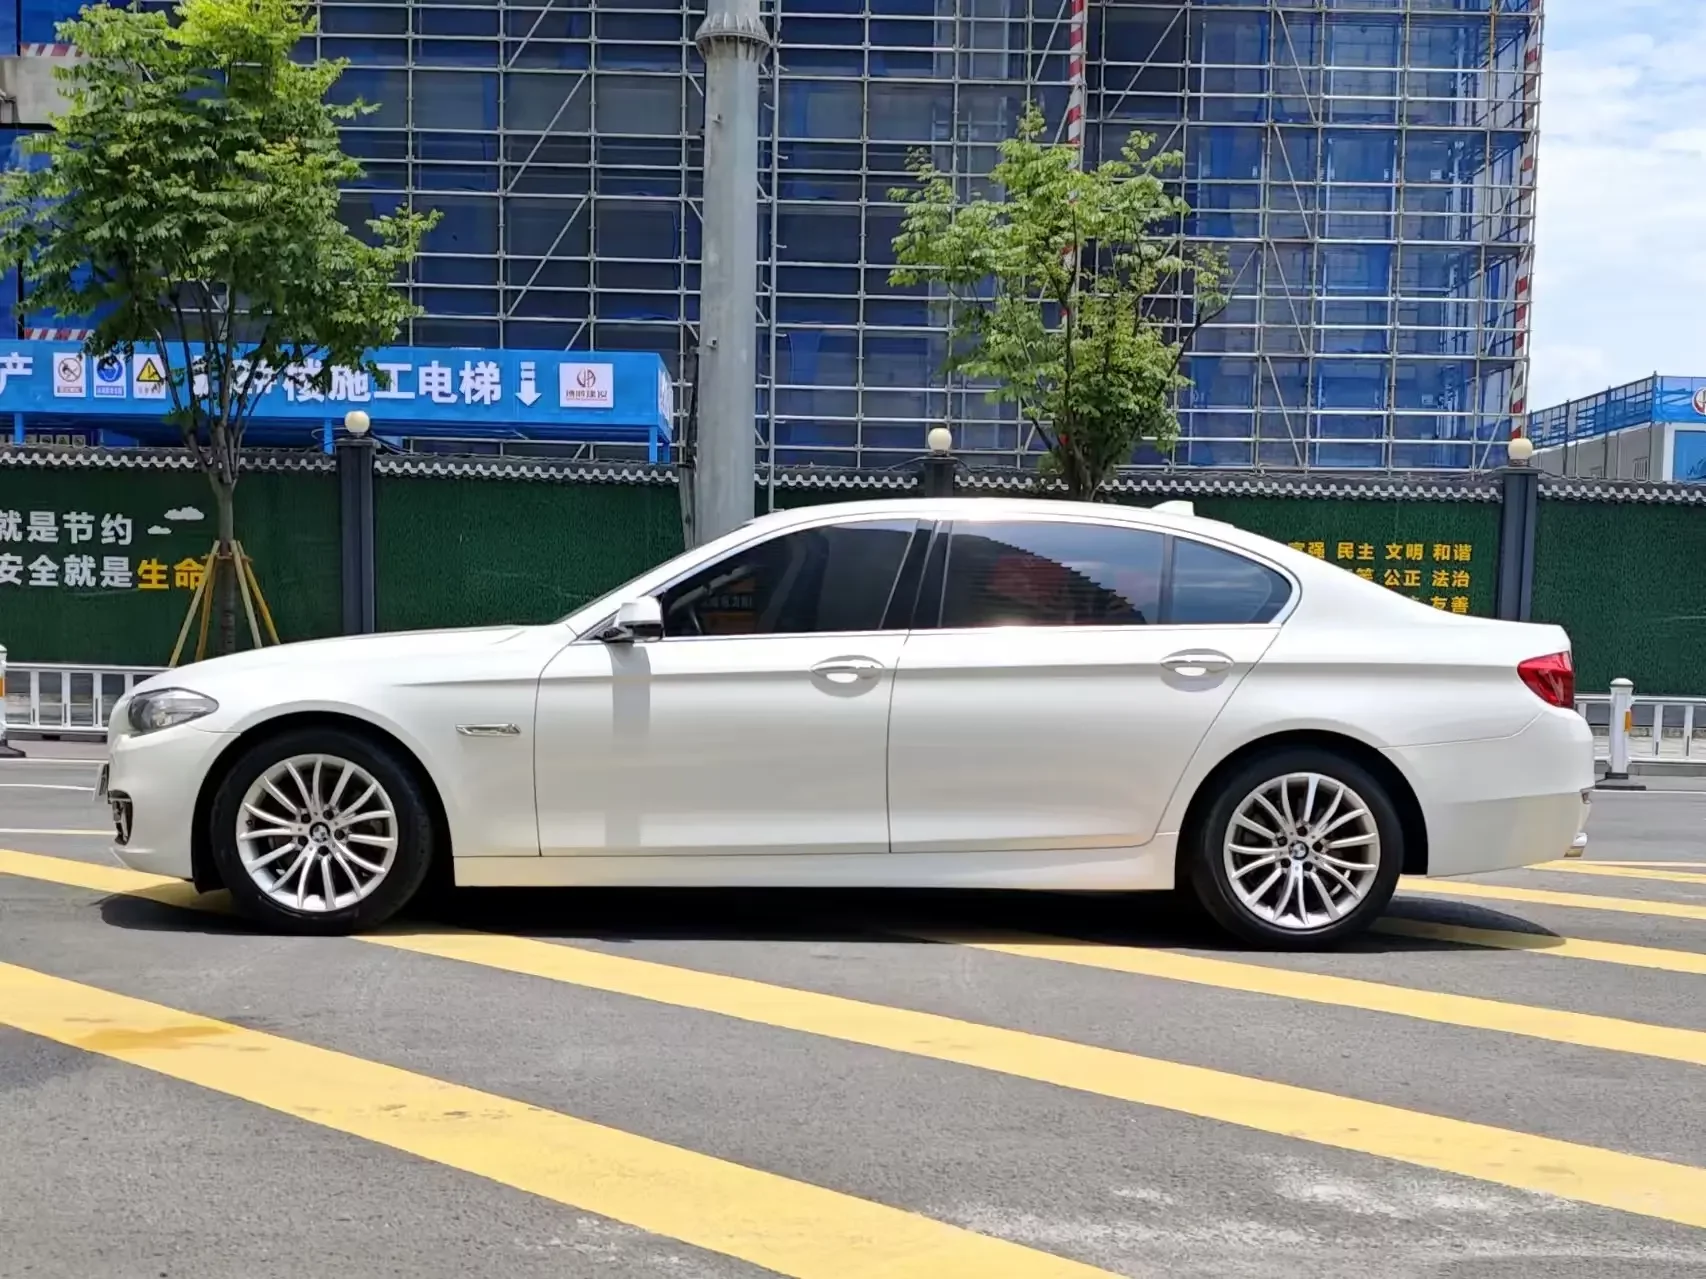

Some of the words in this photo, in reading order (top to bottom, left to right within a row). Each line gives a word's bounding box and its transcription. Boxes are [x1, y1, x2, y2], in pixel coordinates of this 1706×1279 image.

[0, 510, 133, 545] 就是节约
[1337, 542, 1375, 560] 民主
[1385, 543, 1423, 561] 文明
[1432, 543, 1472, 561] 和谐
[0, 553, 207, 591] 安全就是生命
[1384, 568, 1421, 587] 公正
[1432, 570, 1470, 588] 法治
[1431, 595, 1469, 613] 友善
